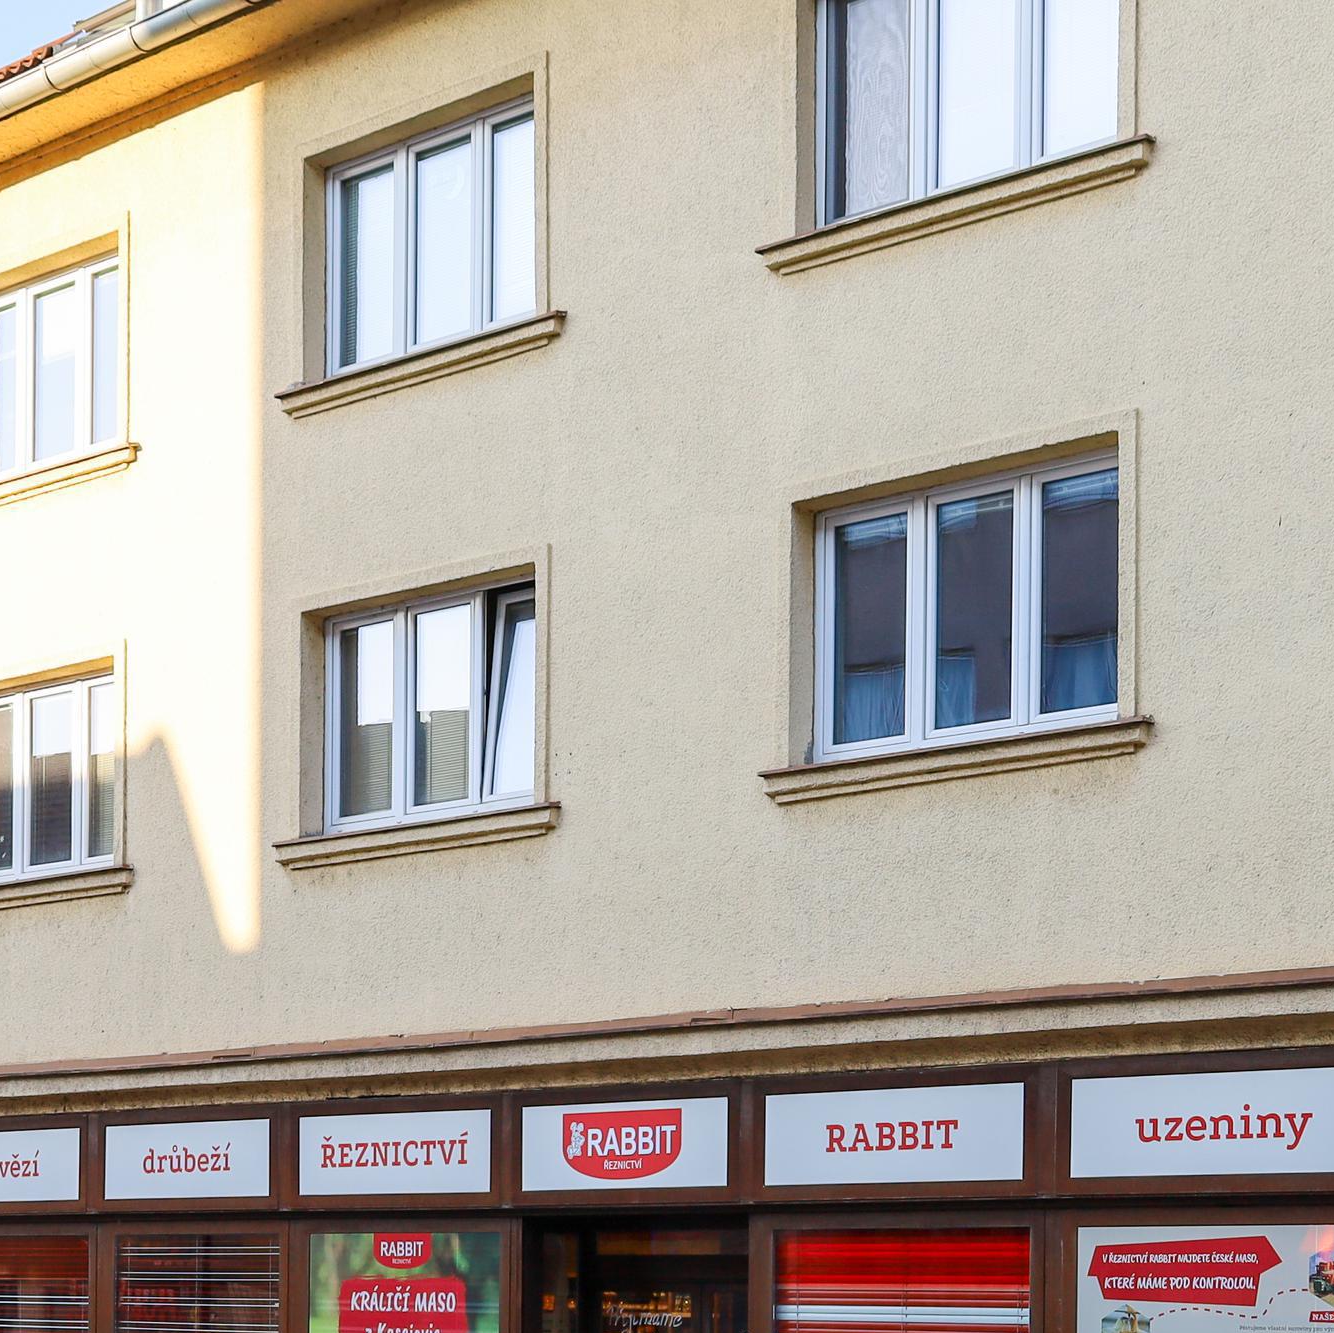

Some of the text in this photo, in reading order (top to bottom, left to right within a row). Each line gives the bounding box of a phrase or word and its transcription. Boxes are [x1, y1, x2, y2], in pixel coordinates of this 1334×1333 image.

[587, 1124, 676, 1157] RABBIT
[826, 1120, 958, 1153] RABBIT
[1135, 1104, 1313, 1150] uzeniny
[143, 1142, 231, 1174] drůbeží
[321, 1130, 468, 1169] ŘEZNICTVÍ
[603, 1158, 642, 1170] ŘEZNICTVÍ
[380, 1241, 423, 1256] RABBIT
[1102, 1251, 1259, 1264] V ŘEZNICTVÍ RABBIT NAJDETE ČESKÉ MASO,
[1104, 1273, 1256, 1290] KTERÉ MÁME POD KONTROLOU.
[351, 1286, 456, 1312] KRÁLIČÍ MASO
